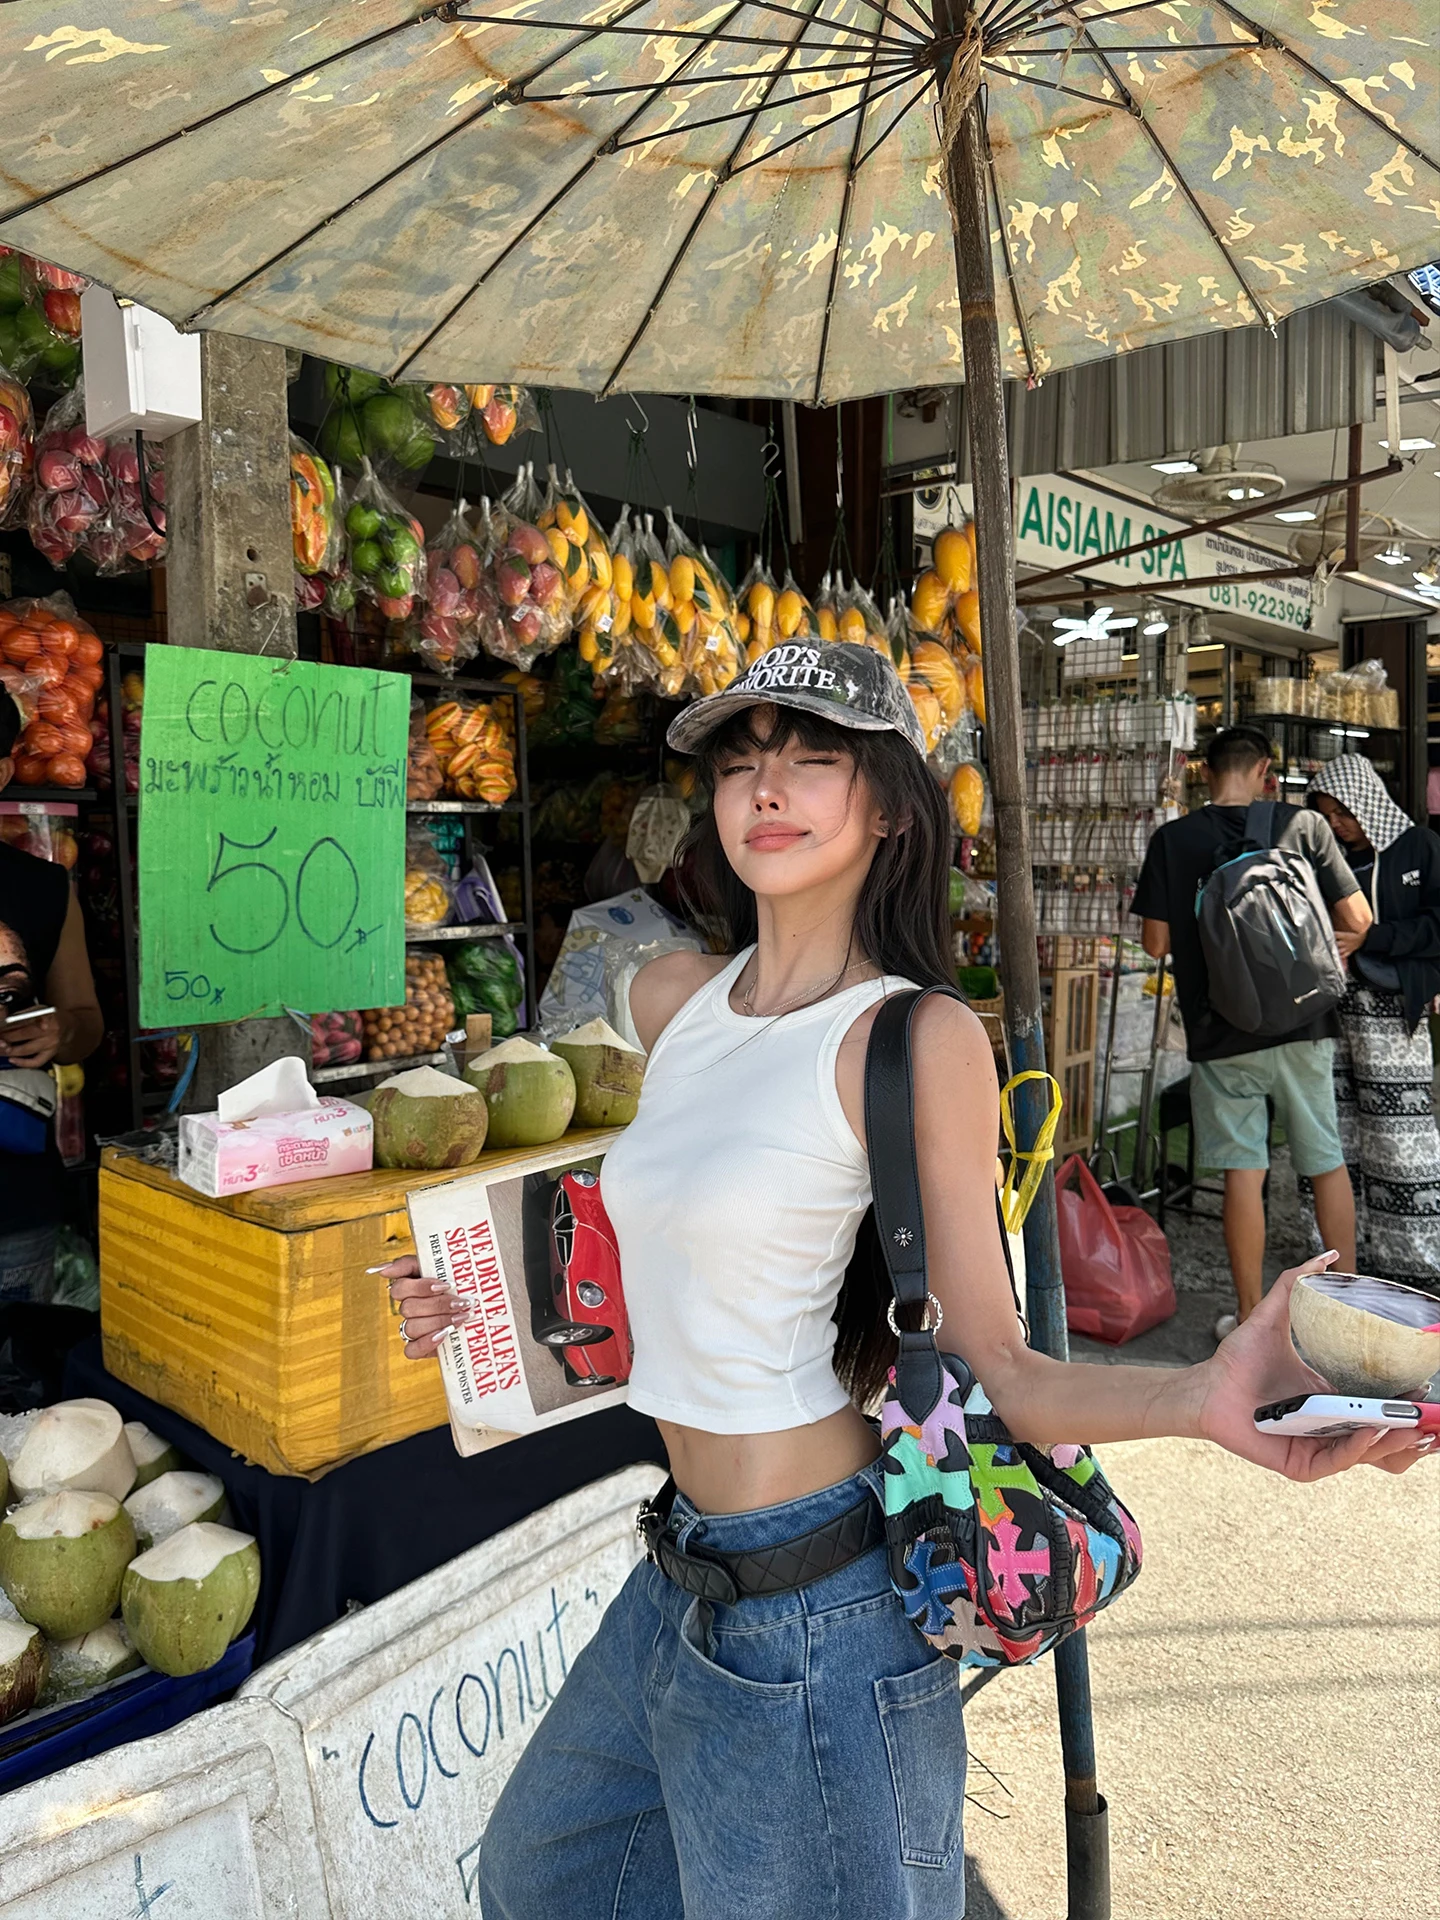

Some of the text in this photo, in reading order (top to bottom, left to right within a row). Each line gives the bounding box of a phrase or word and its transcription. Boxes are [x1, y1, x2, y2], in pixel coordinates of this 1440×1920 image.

[1141, 524, 1188, 581] SPA
[429, 1233, 441, 1256] FREE
[446, 1227, 478, 1296] SECRET
[468, 1218, 522, 1391] WE DRIVE ALFA'S
[449, 1330, 460, 1344] LE
[452, 1343, 466, 1371] MANS
[457, 1371, 474, 1404] POSTER
